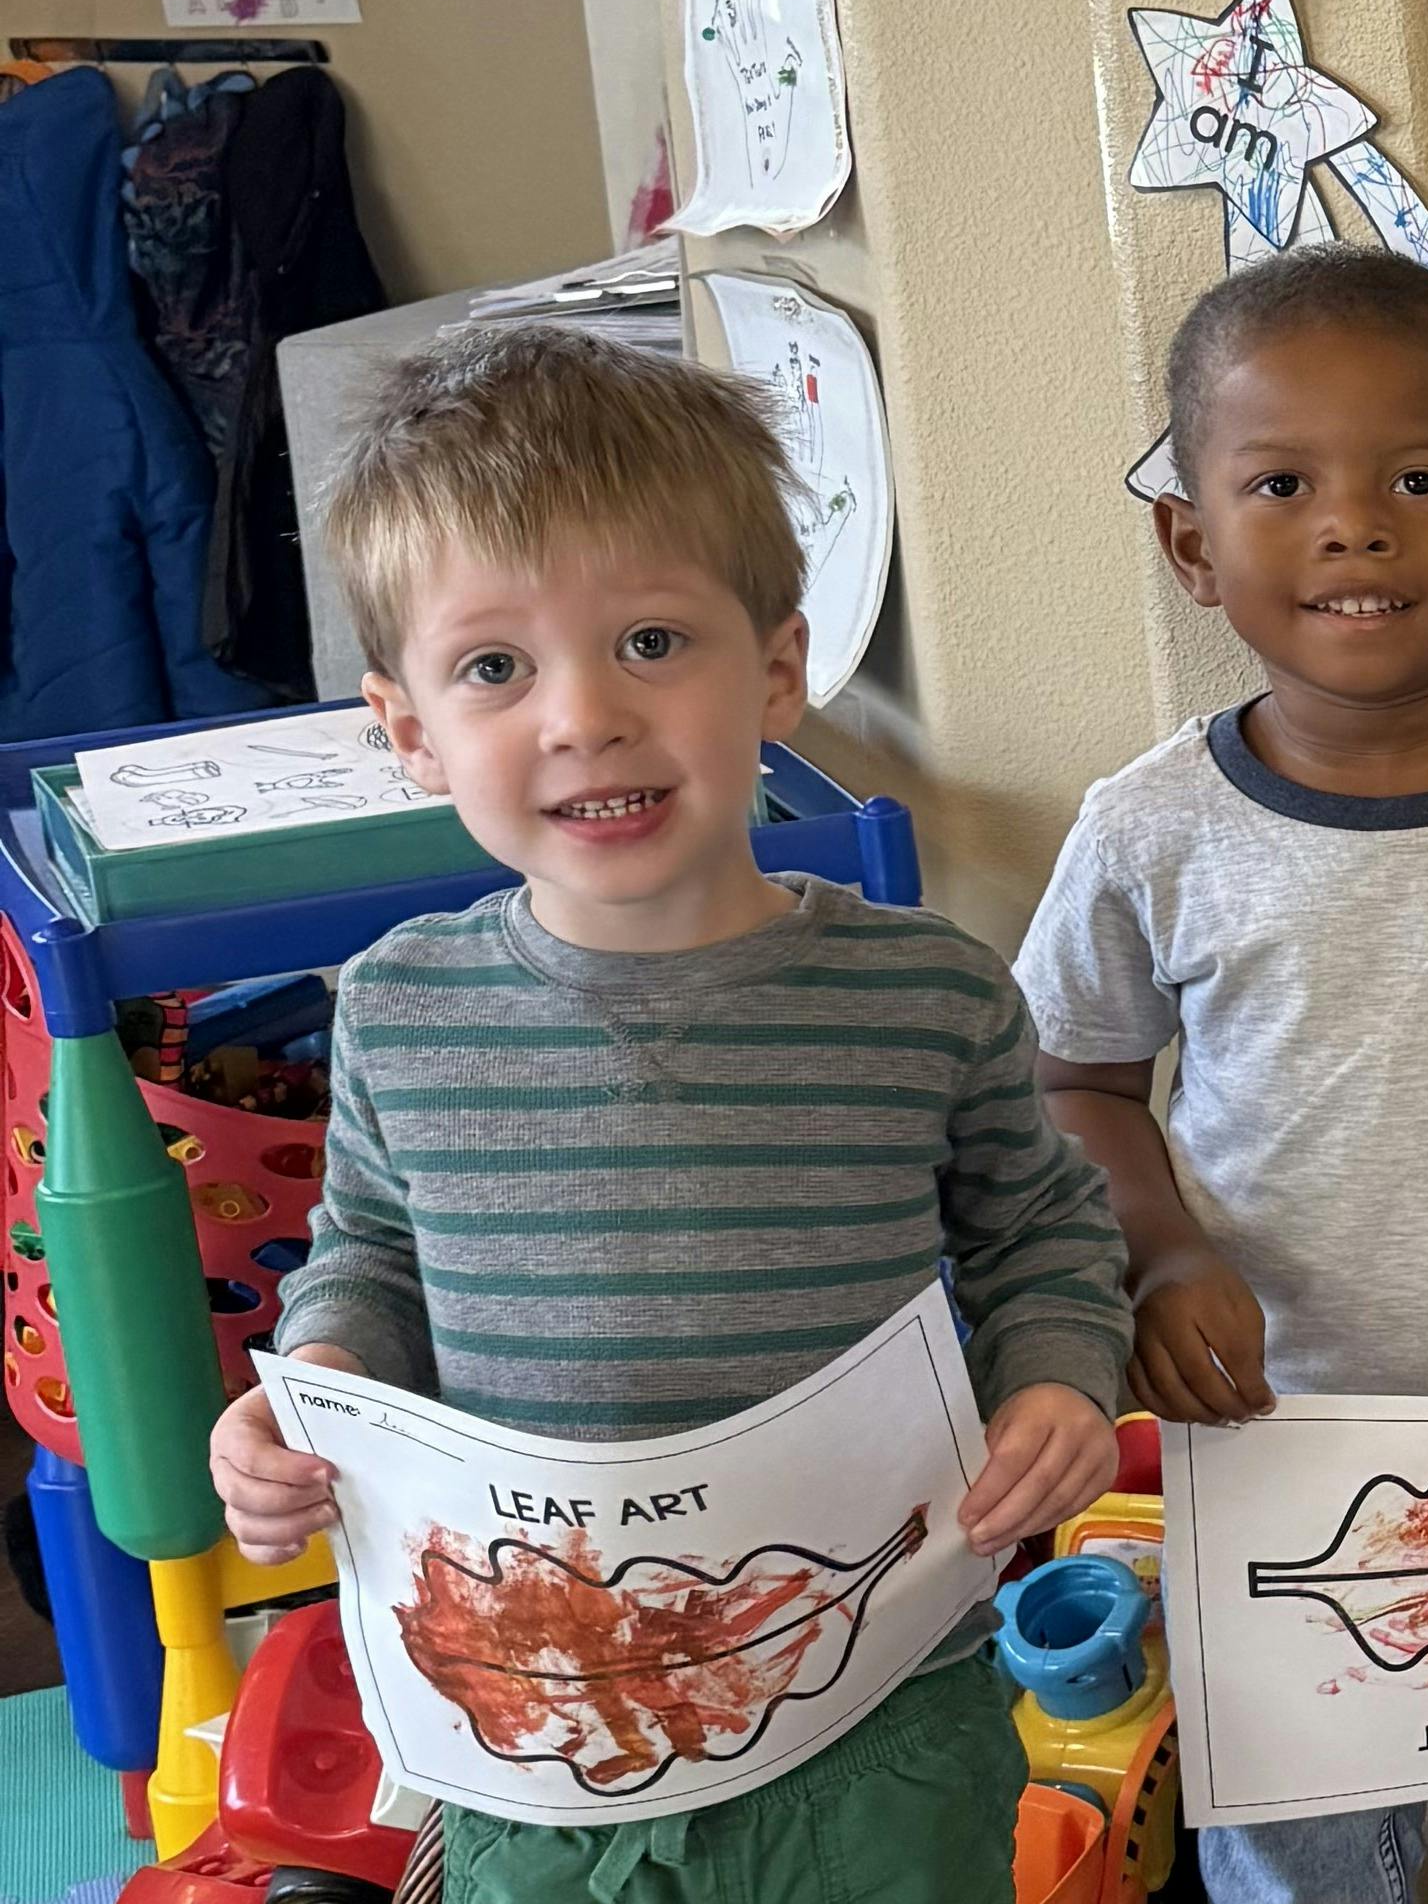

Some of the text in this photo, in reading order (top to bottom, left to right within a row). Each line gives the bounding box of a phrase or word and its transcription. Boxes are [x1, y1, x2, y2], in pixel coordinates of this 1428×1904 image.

[1239, 34, 1274, 95] I
[1189, 103, 1279, 172] am
[298, 1388, 363, 1420] name:
[488, 1481, 711, 1528] LEAF ART
